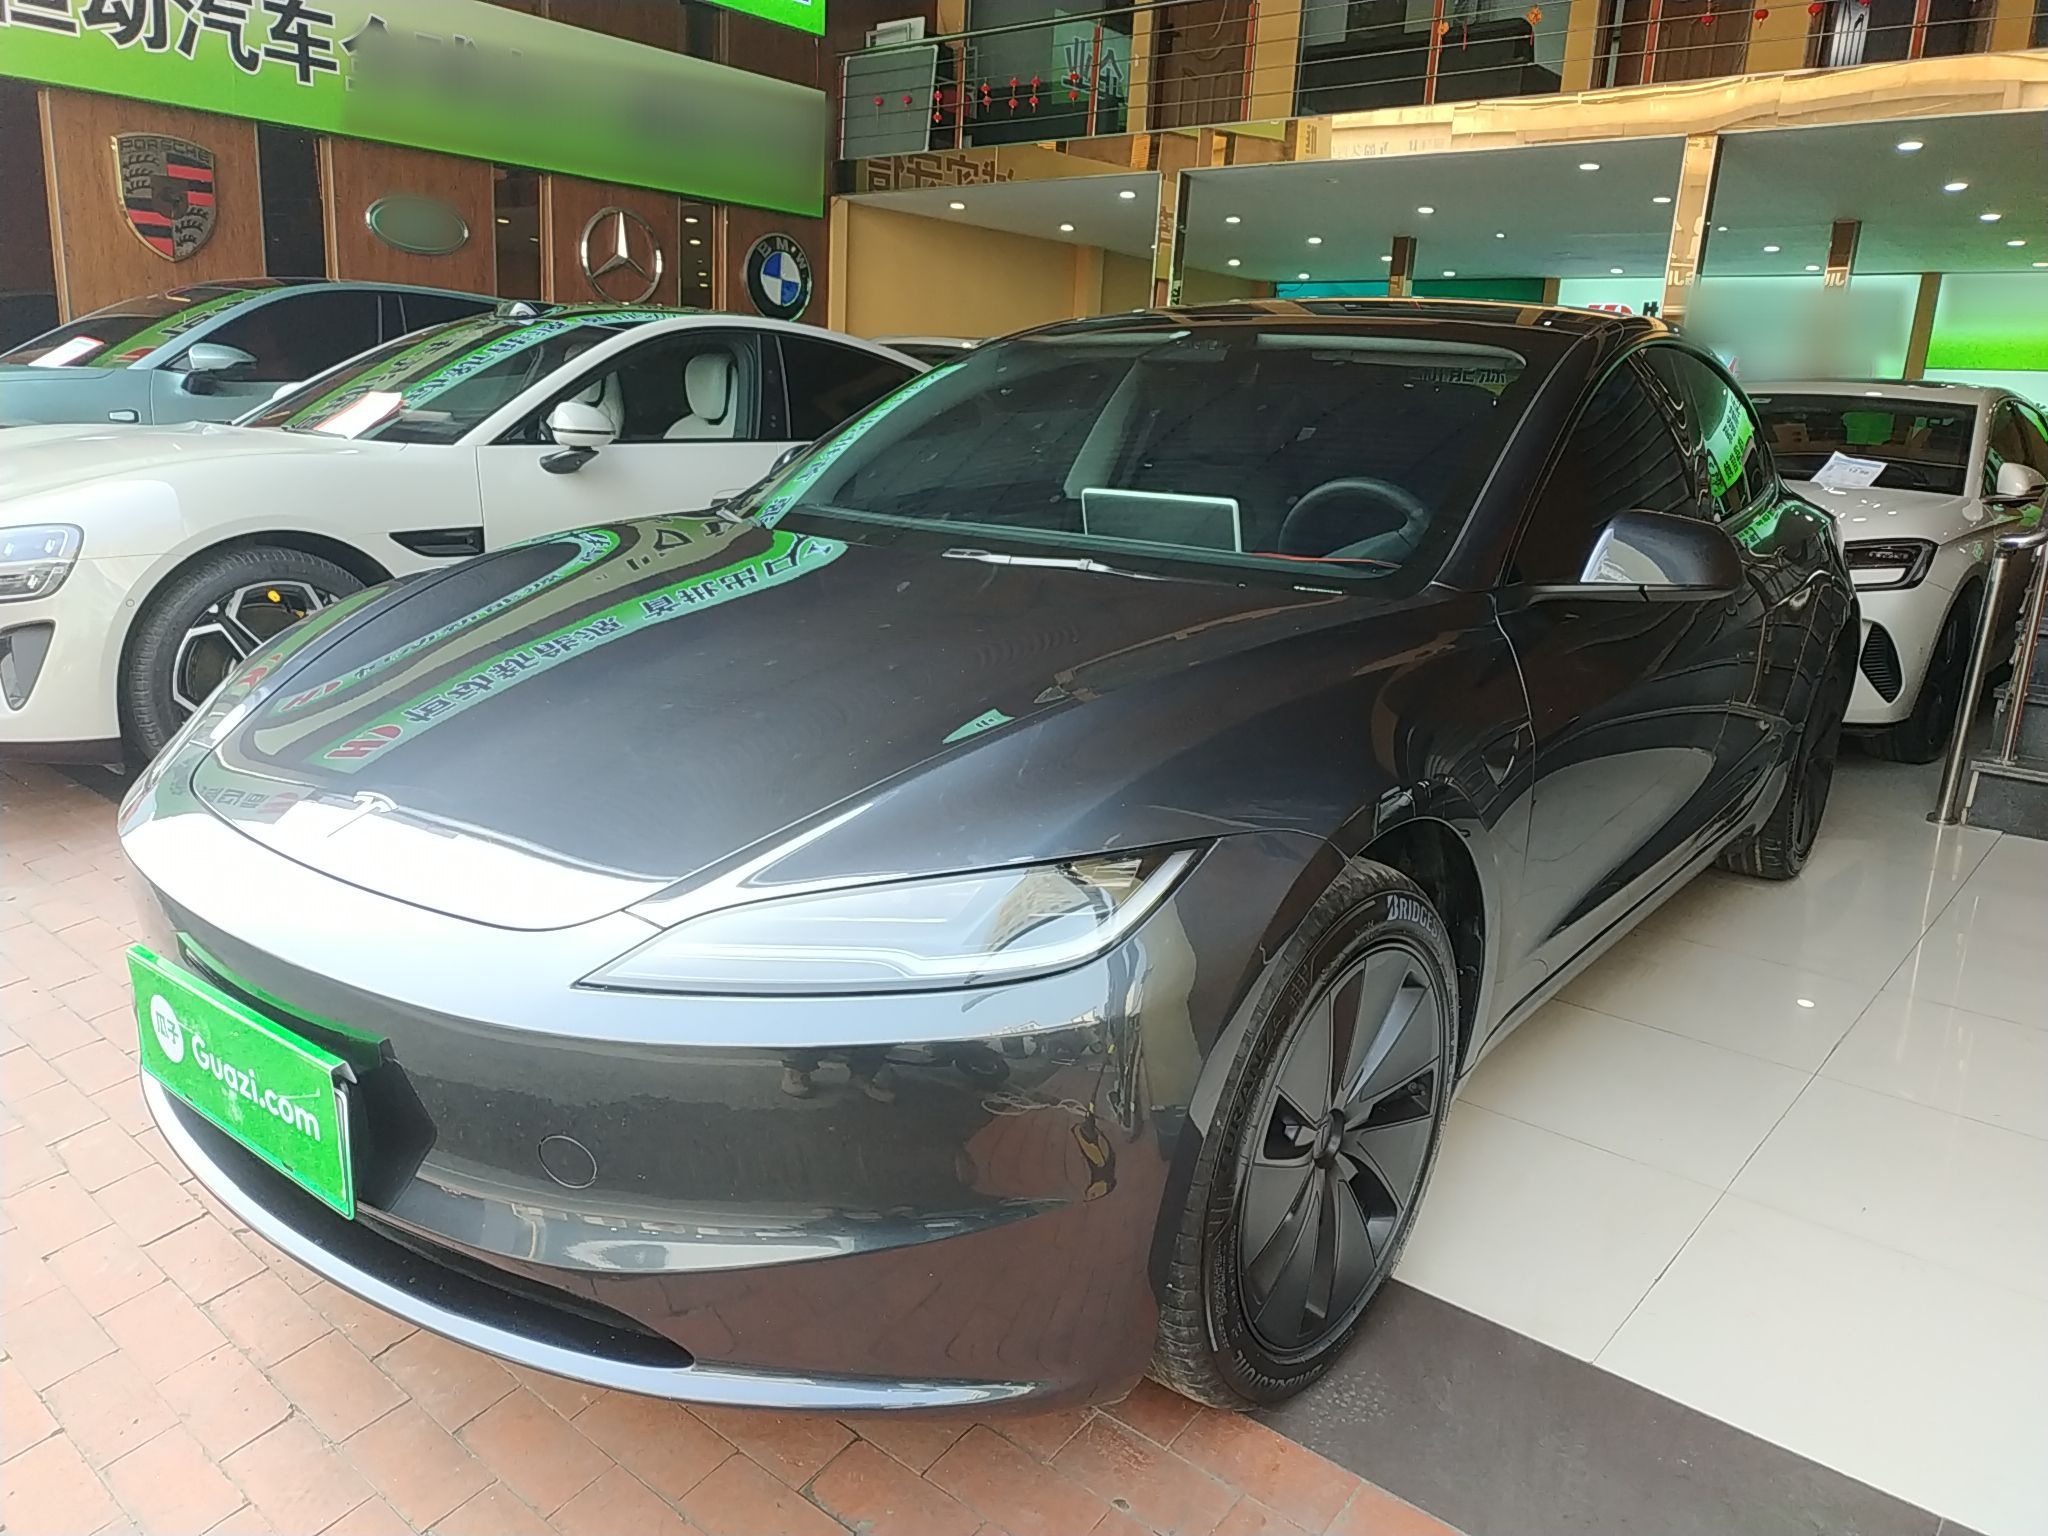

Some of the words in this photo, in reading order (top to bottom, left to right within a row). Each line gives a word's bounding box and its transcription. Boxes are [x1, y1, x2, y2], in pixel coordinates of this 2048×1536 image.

[120, 139, 211, 164] PORSCHE
[756, 236, 807, 270] BMW
[191, 1034, 321, 1142] Guazi.com
